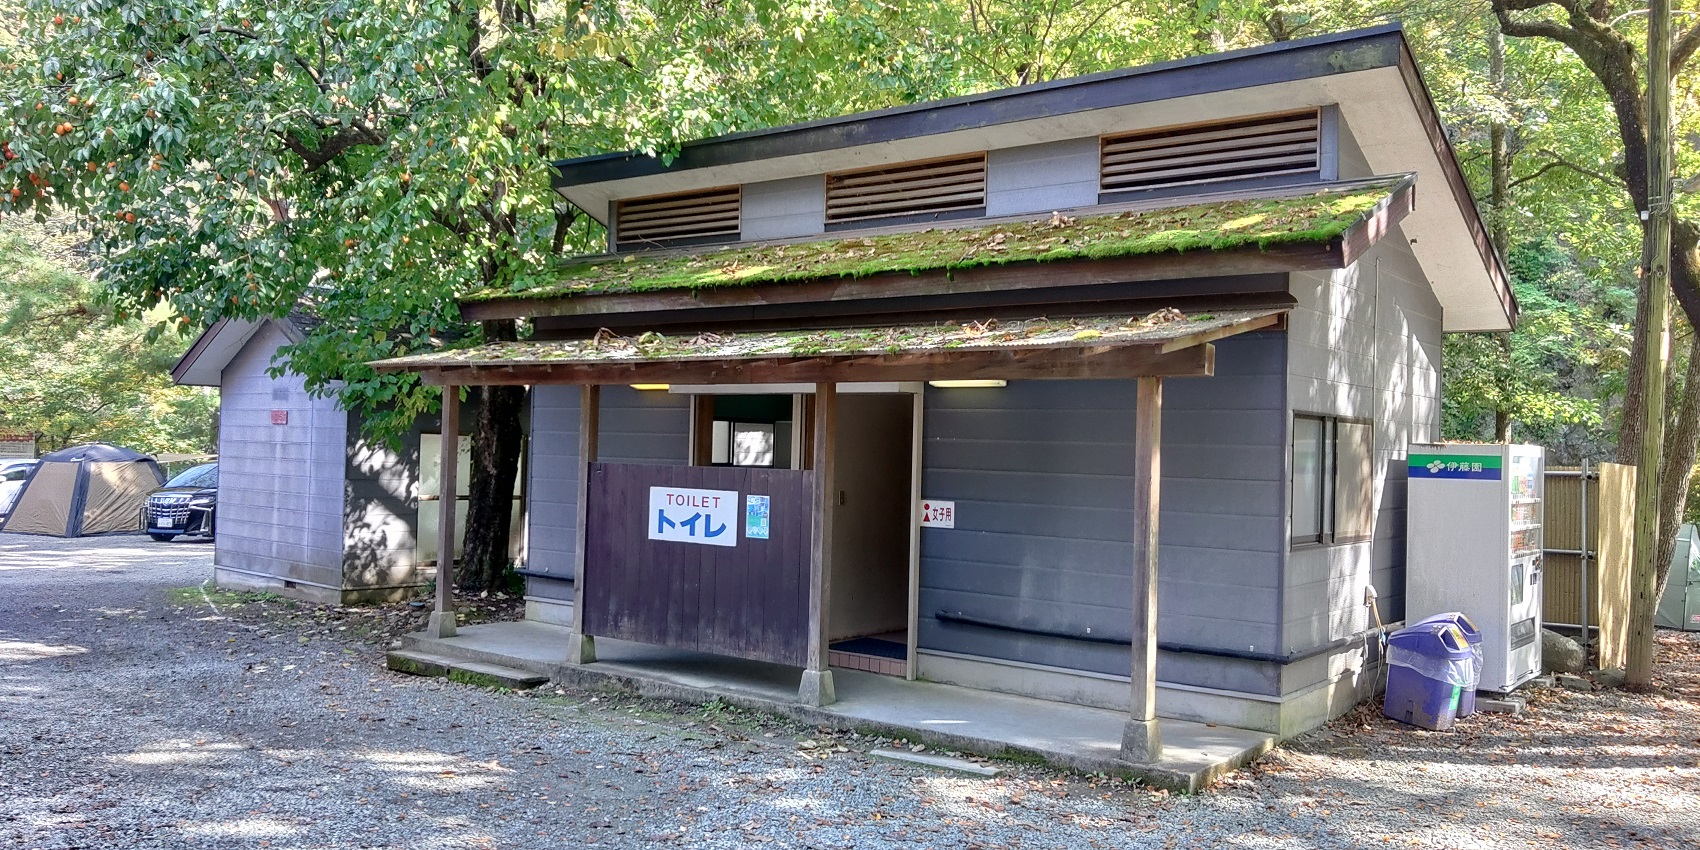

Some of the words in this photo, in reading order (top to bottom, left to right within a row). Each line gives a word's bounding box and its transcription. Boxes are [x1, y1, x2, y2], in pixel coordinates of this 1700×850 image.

[1446, 461, 1483, 472] 伊藤園
[666, 493, 721, 508] TOILET
[932, 506, 952, 522] 女子用
[657, 508, 727, 538] トイレ
